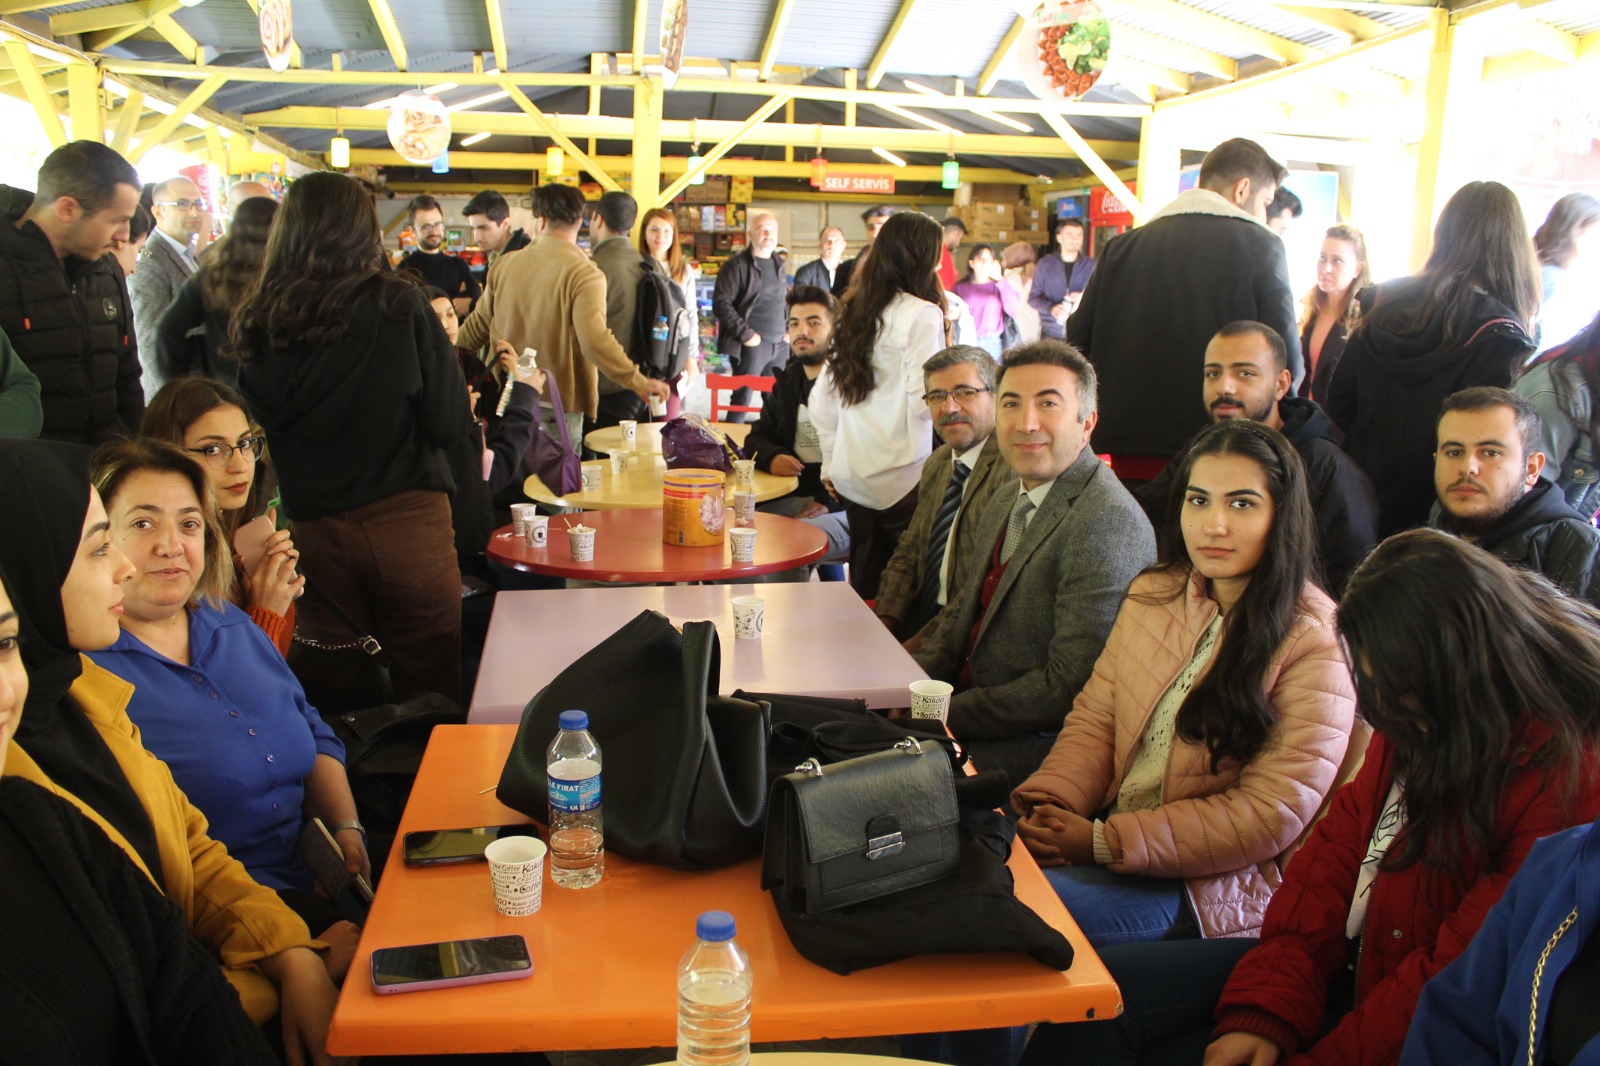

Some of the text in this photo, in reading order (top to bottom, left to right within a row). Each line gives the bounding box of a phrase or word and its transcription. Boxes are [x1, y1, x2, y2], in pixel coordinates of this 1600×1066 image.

[825, 176, 889, 190] SELF SERVİS
[920, 711, 942, 719] Coffee
[556, 784, 580, 792] FIRAT
[501, 864, 521, 872] Coffee
